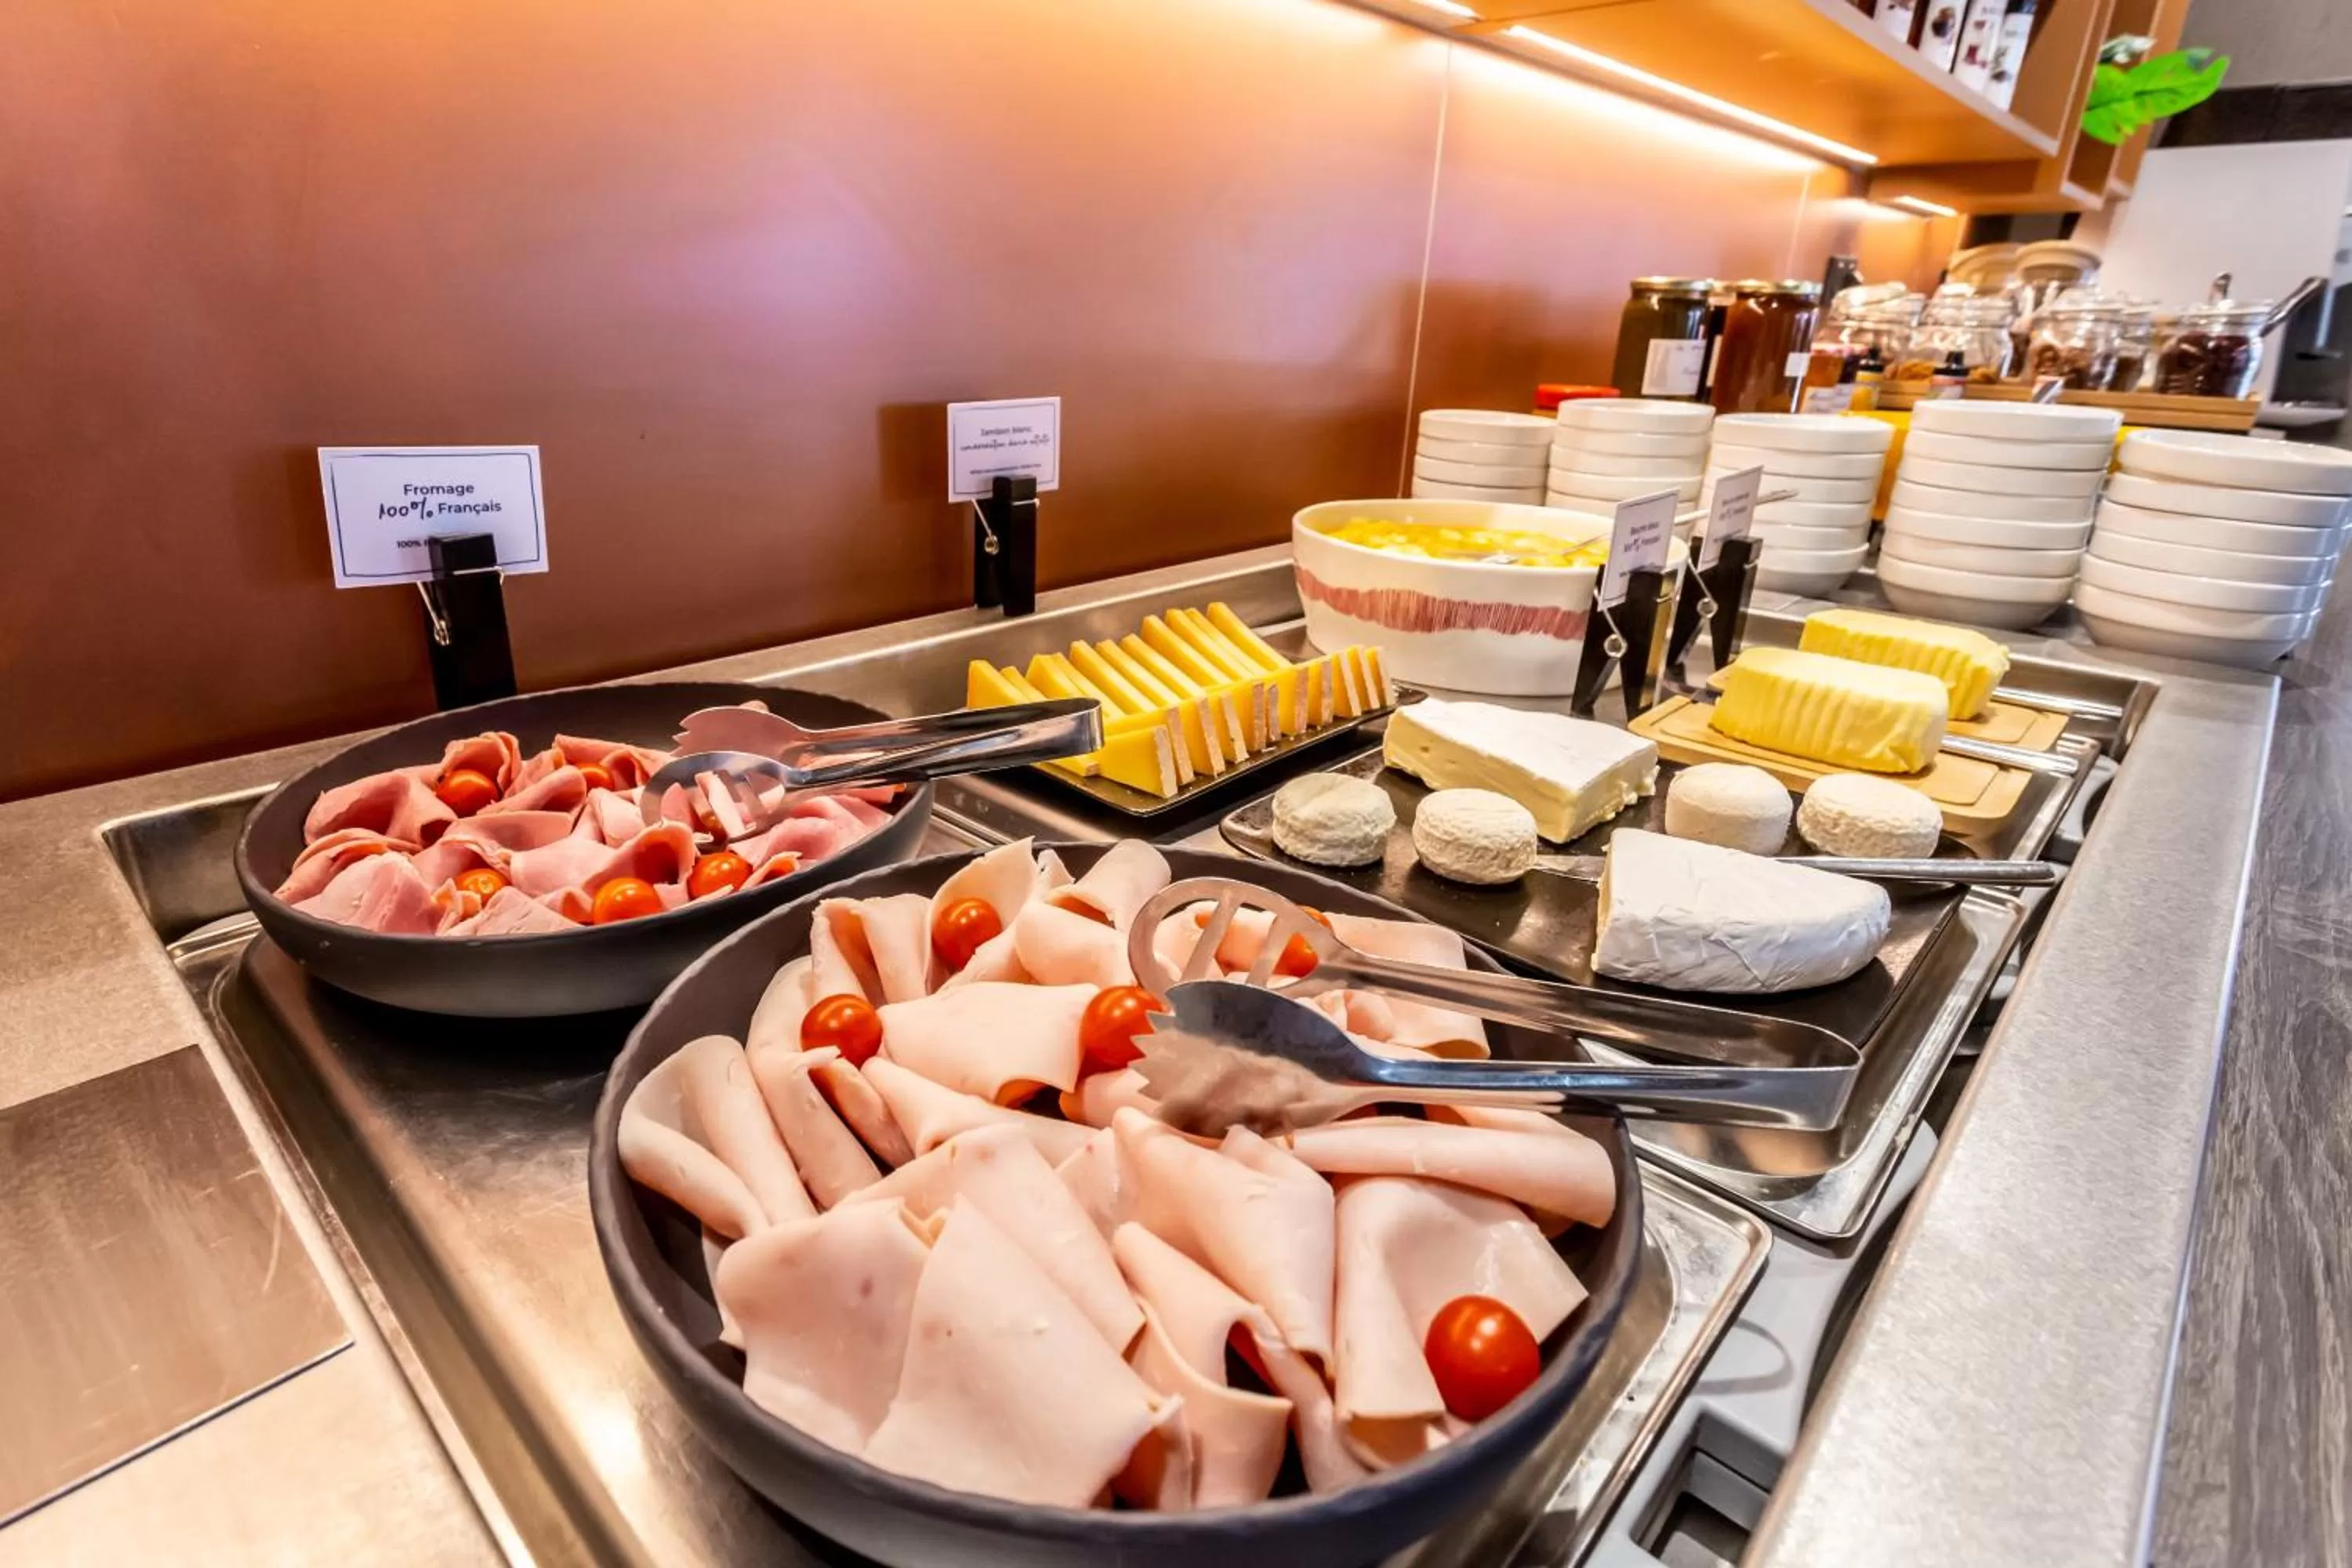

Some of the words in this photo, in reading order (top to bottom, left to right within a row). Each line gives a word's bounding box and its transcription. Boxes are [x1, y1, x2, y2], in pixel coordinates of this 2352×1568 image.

[404, 484, 475, 496] Fromage
[379, 497, 434, 520] 100%
[437, 499, 503, 514] Français
[397, 539, 422, 548] 100%
